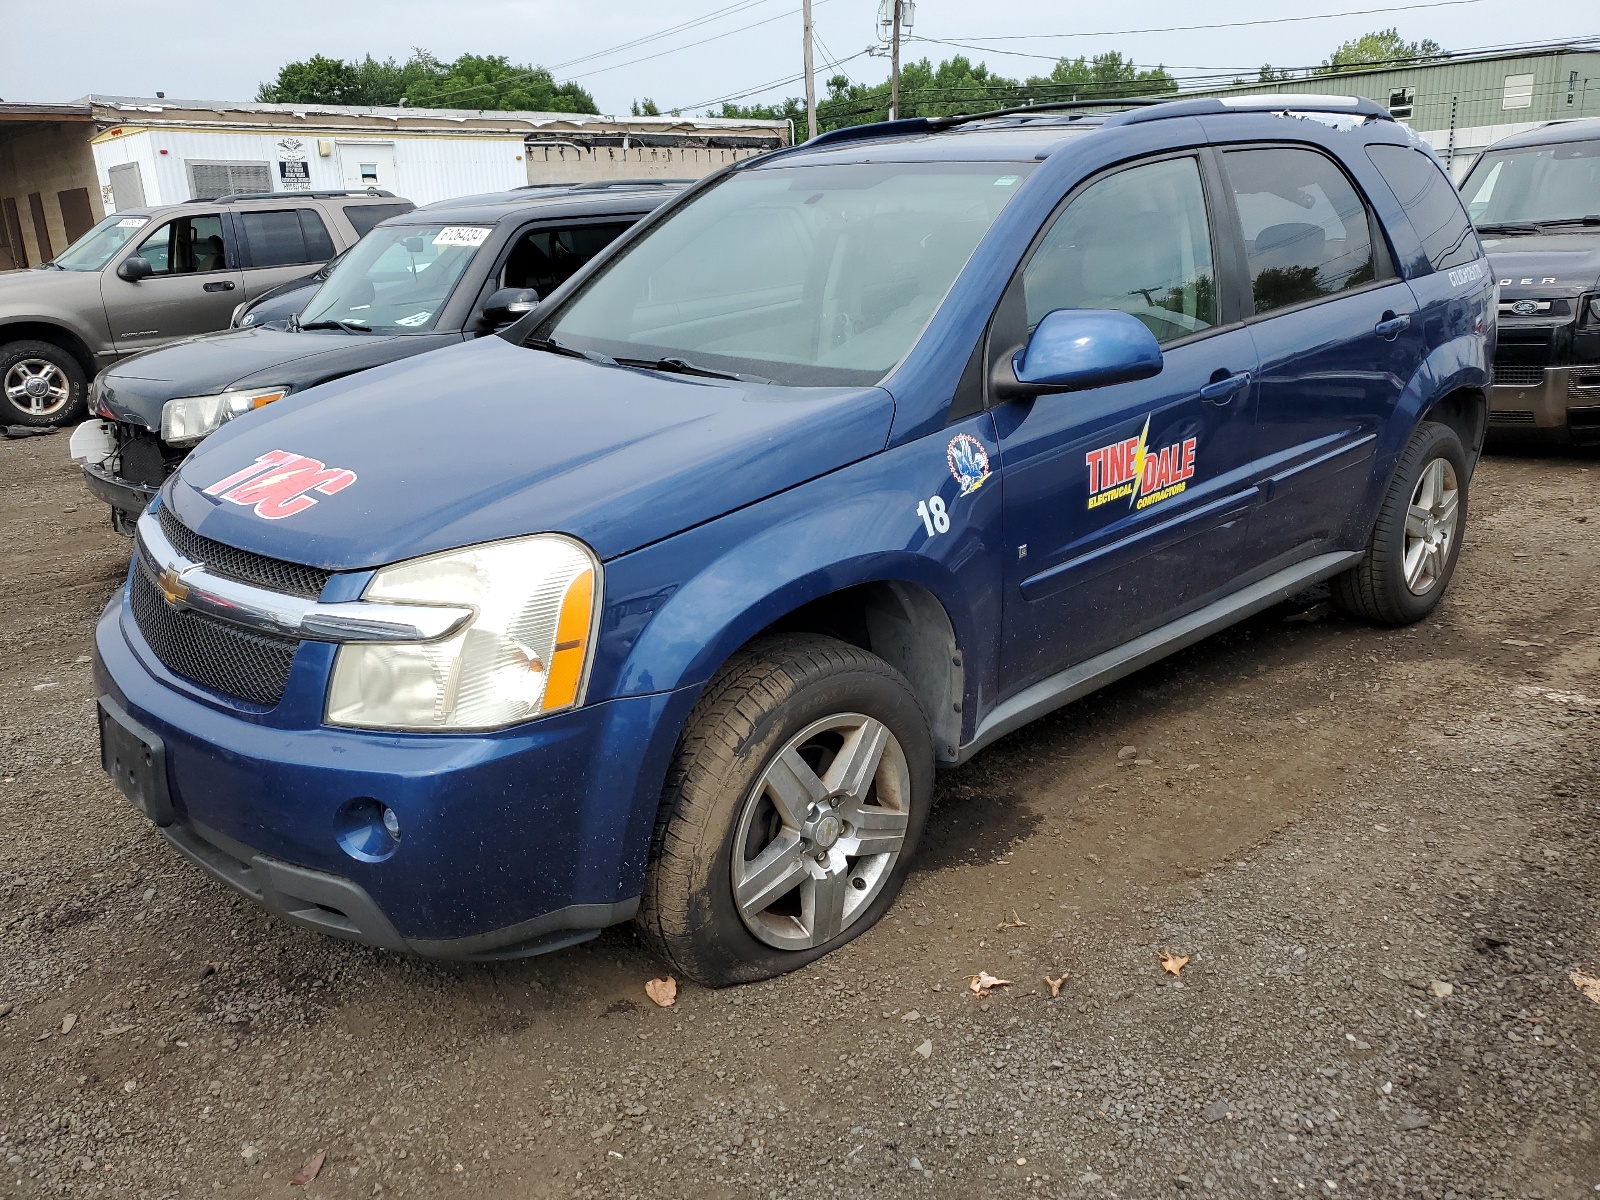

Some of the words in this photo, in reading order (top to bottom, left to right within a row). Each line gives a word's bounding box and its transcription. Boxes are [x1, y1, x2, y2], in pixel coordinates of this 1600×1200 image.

[1085, 435, 1139, 496] TINE
[1141, 437, 1197, 497] DALE
[916, 494, 951, 537] 18
[1087, 483, 1133, 510] ELECTRICAL
[1136, 482, 1187, 510] CONTRACTORS
